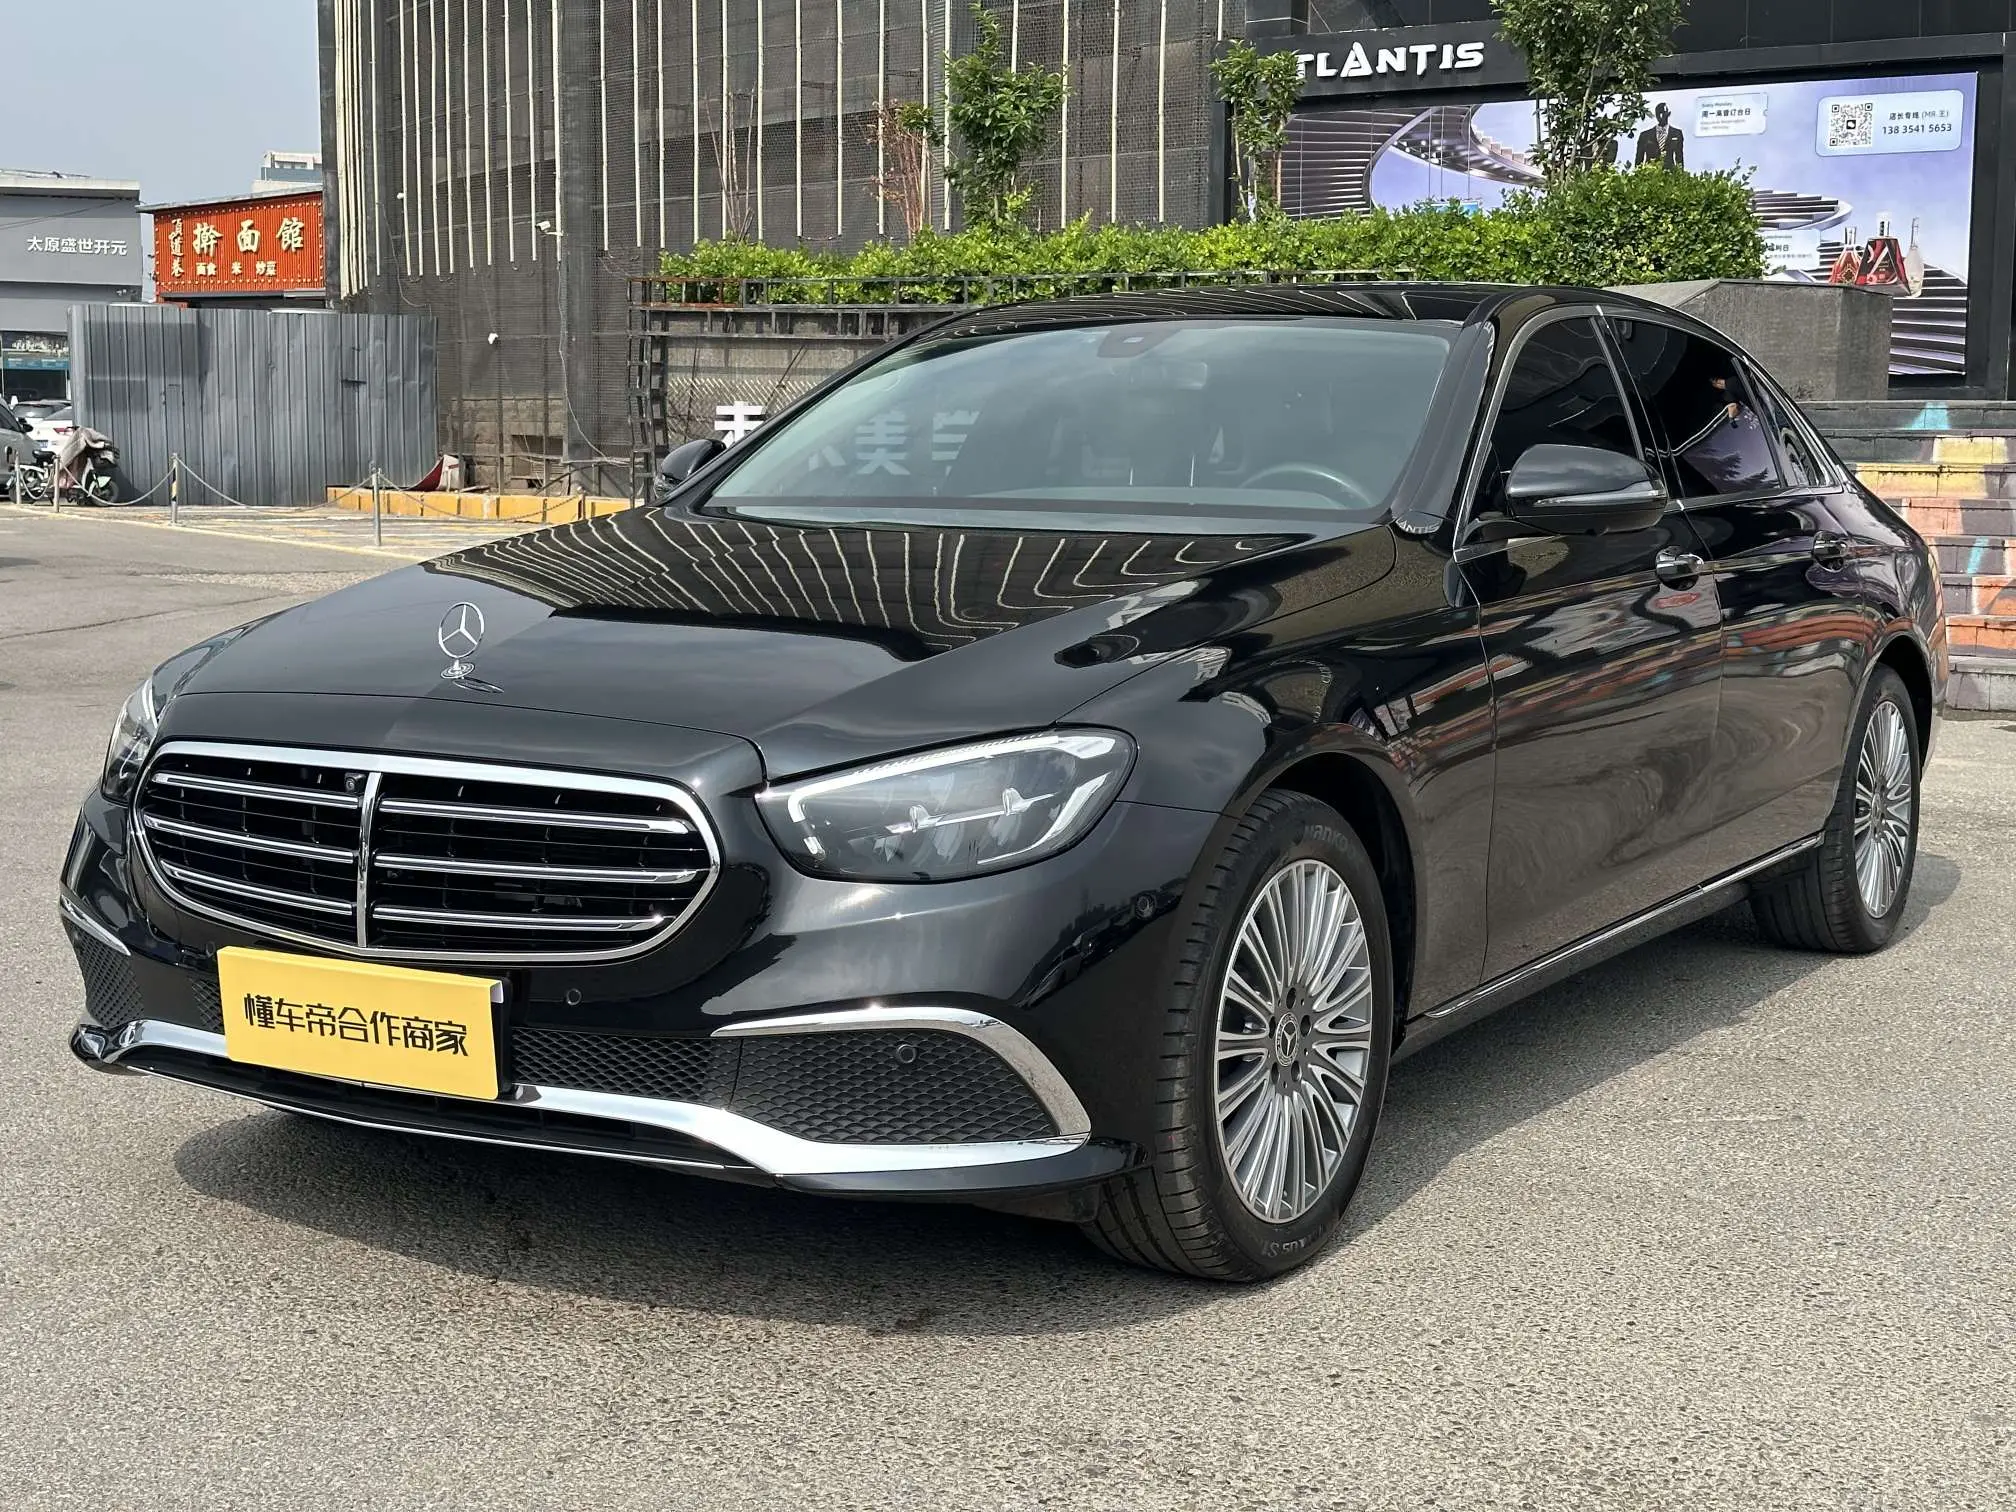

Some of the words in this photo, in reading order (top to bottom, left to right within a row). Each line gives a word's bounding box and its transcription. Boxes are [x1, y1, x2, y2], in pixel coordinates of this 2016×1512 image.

[1294, 42, 1485, 78] TLANTIS
[1882, 125, 1899, 135] 138
[1902, 124, 1925, 133] 3541
[1928, 123, 1952, 132] 5653
[27, 236, 128, 255] 太原盛世开元
[243, 992, 469, 1057] 懂车帝合作商家
